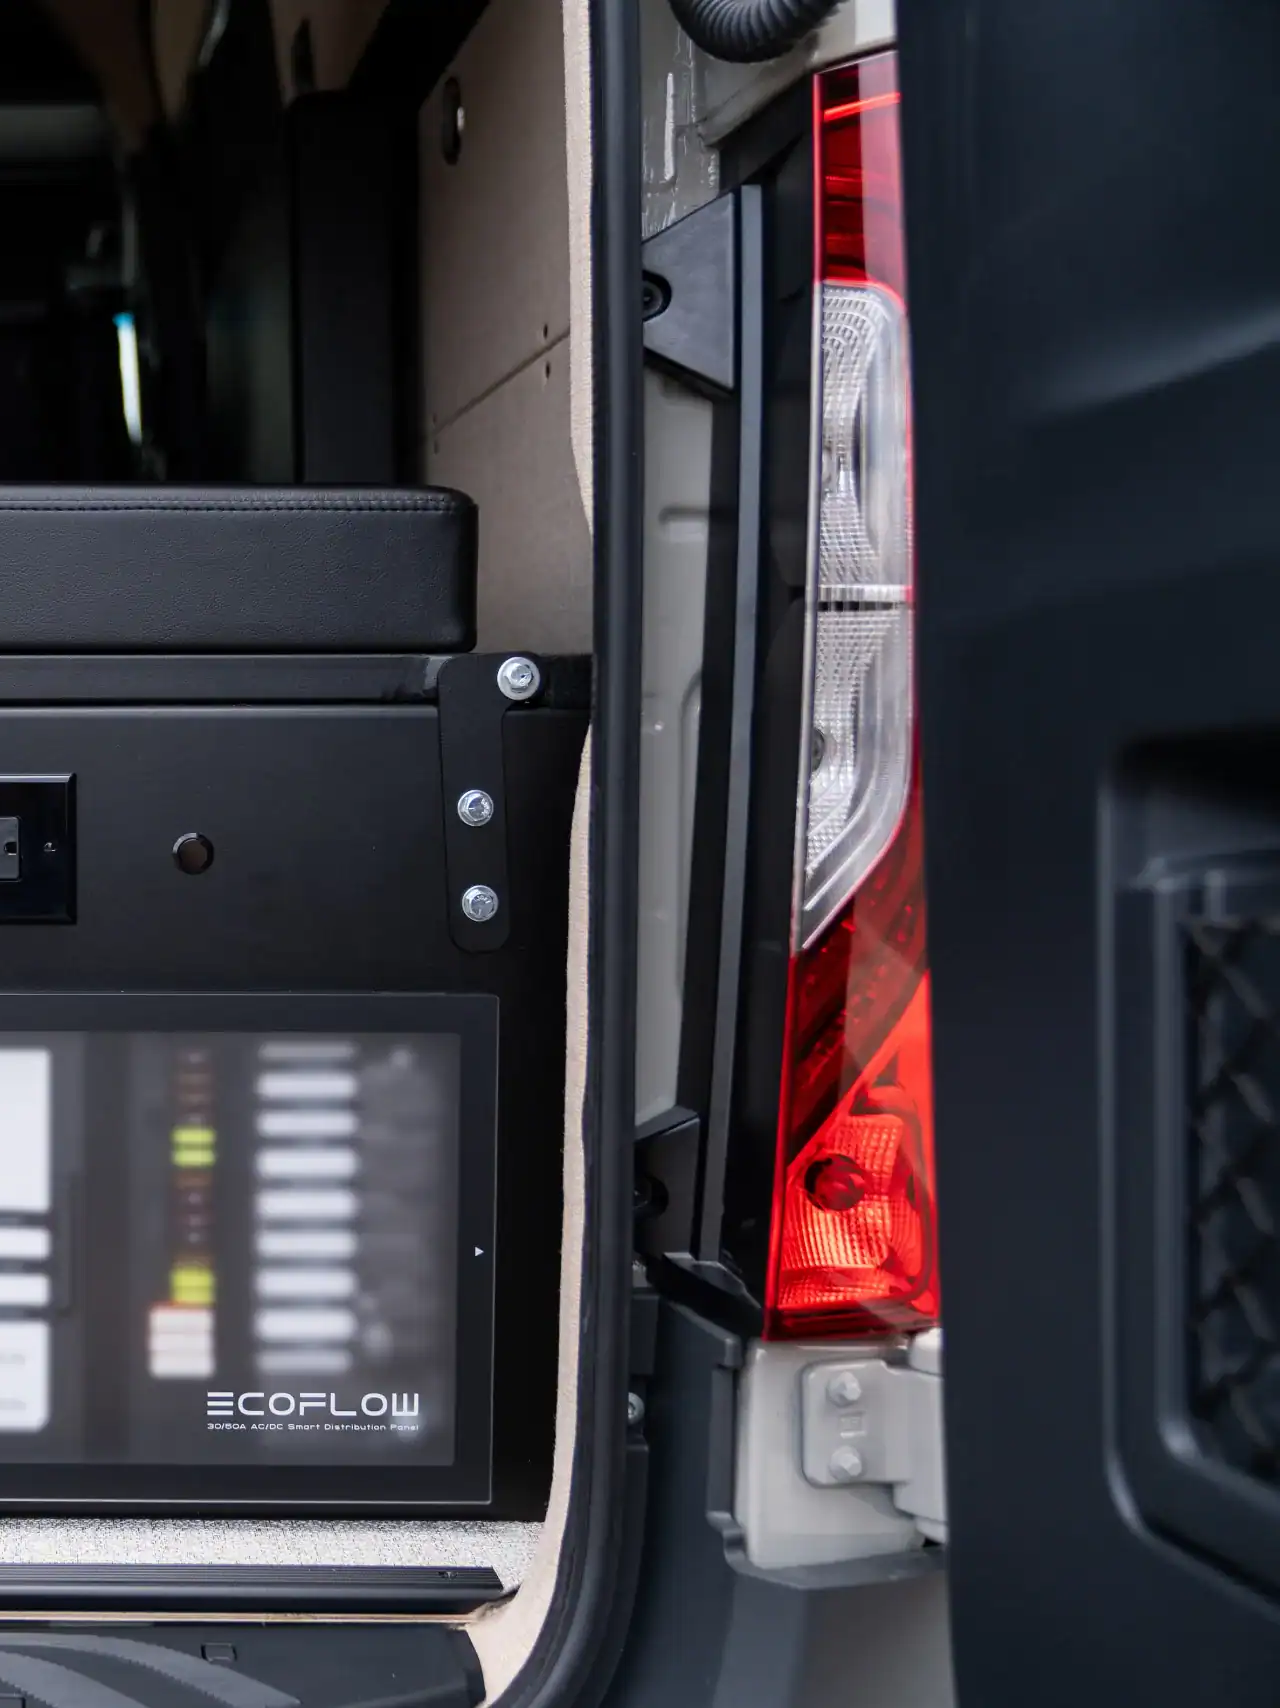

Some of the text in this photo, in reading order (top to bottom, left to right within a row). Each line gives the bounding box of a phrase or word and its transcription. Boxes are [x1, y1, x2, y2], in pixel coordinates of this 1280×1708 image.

[206, 1391, 419, 1417] ECOFLOW
[206, 1422, 419, 1431] 30/50A AC/DC Smart Distribution Panel
